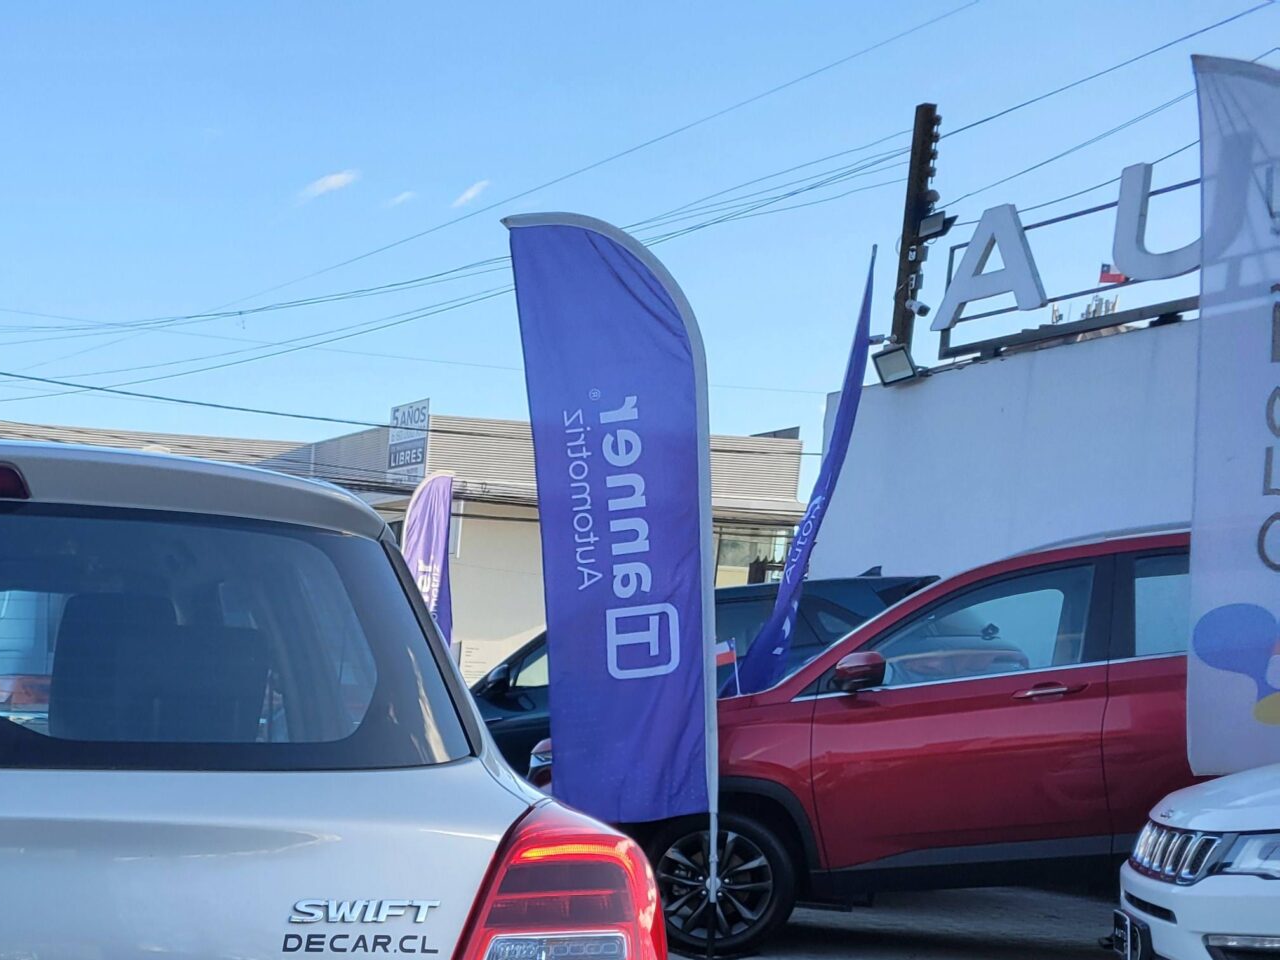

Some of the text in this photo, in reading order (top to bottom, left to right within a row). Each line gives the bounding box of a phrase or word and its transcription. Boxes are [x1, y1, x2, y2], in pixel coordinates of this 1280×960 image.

[401, 405, 427, 426] AÑOS
[390, 448, 423, 467] LIBRES
[288, 899, 441, 924] SWIFT
[281, 933, 439, 954] DECAR.CL
